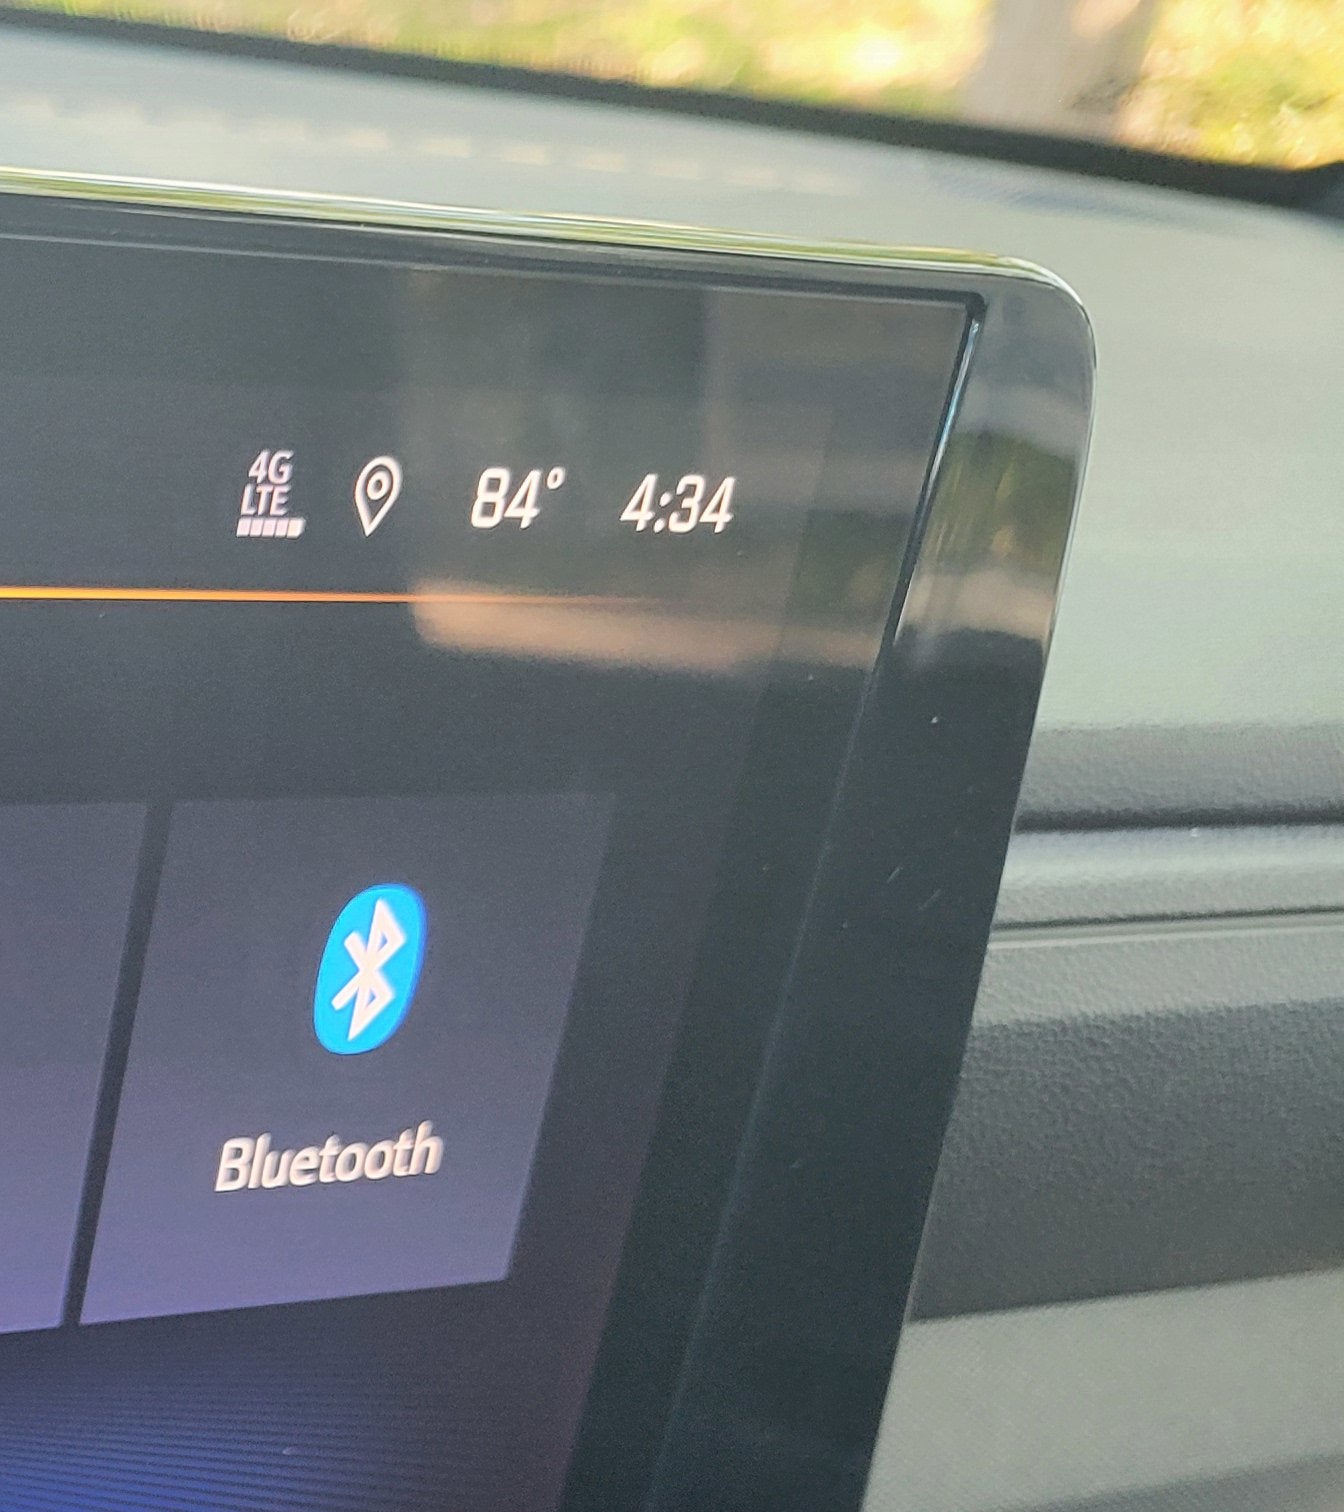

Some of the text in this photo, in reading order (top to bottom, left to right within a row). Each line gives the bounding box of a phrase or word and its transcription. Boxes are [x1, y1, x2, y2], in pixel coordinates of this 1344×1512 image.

[246, 448, 294, 484] 4G
[240, 483, 291, 516] LTE
[618, 473, 737, 534] 4:34
[214, 1118, 445, 1193] Bluetooth
